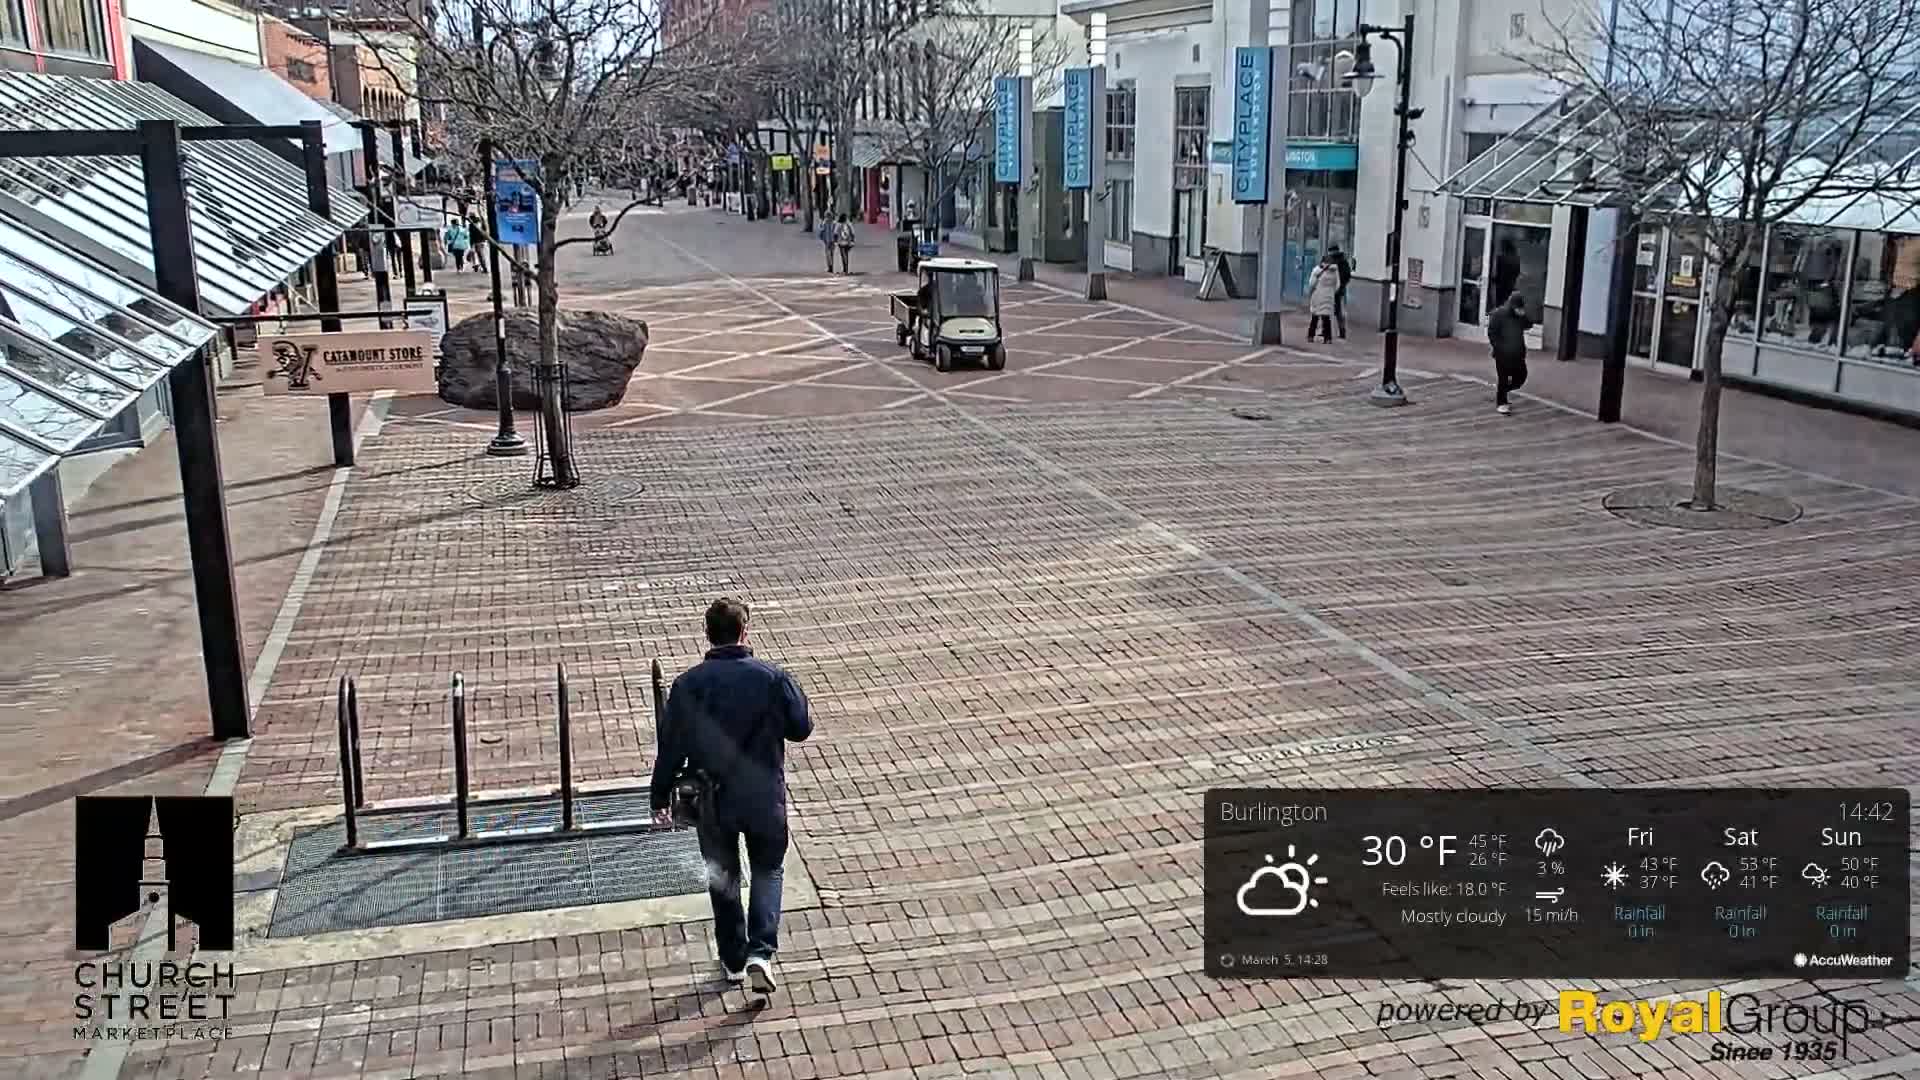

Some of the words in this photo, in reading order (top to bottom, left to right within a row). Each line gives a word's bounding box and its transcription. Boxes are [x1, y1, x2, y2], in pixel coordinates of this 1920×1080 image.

[1067, 73, 1080, 182] CITYPLACE
[1236, 52, 1254, 193] CITYPLACE
[323, 348, 386, 363] CATAMOUNT
[389, 346, 424, 361] STORE
